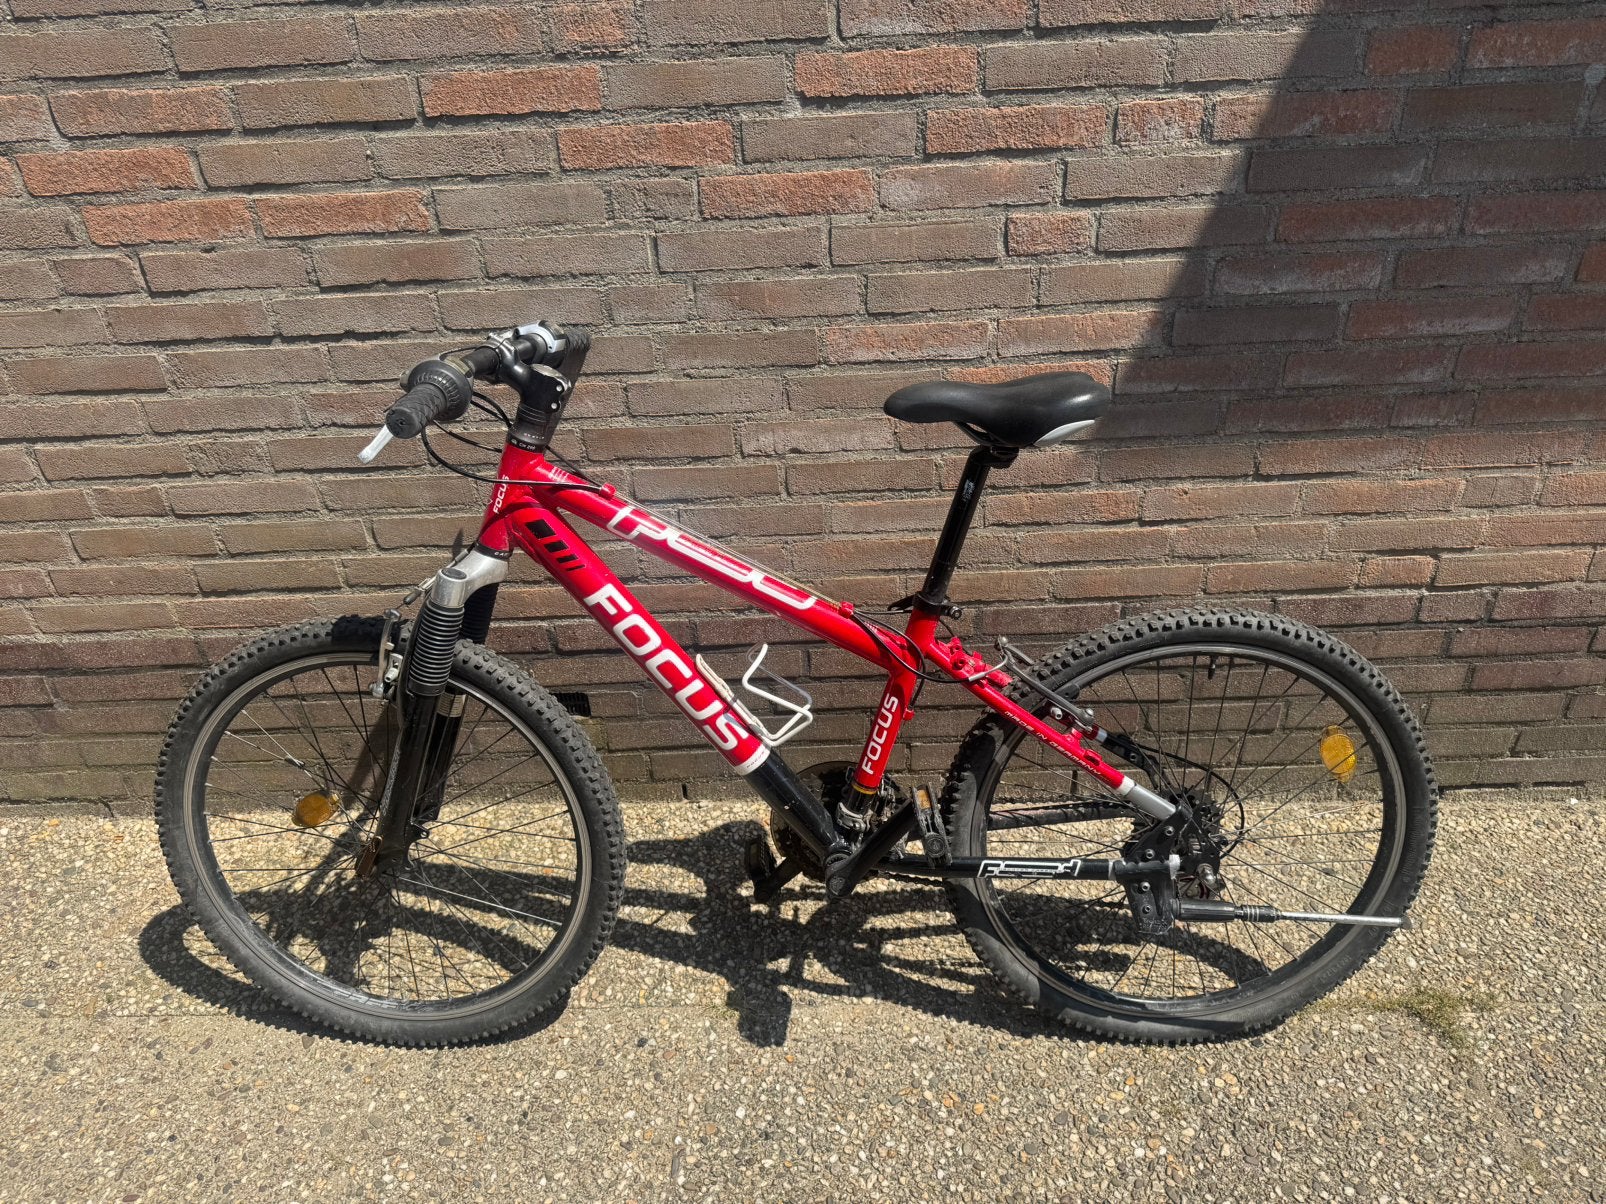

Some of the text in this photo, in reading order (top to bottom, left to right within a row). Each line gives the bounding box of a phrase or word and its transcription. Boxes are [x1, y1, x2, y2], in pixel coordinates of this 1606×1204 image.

[585, 583, 749, 750] FOCUS
[861, 695, 899, 774] FOCUS
[1004, 711, 1102, 775] MADE IN GERMANY
